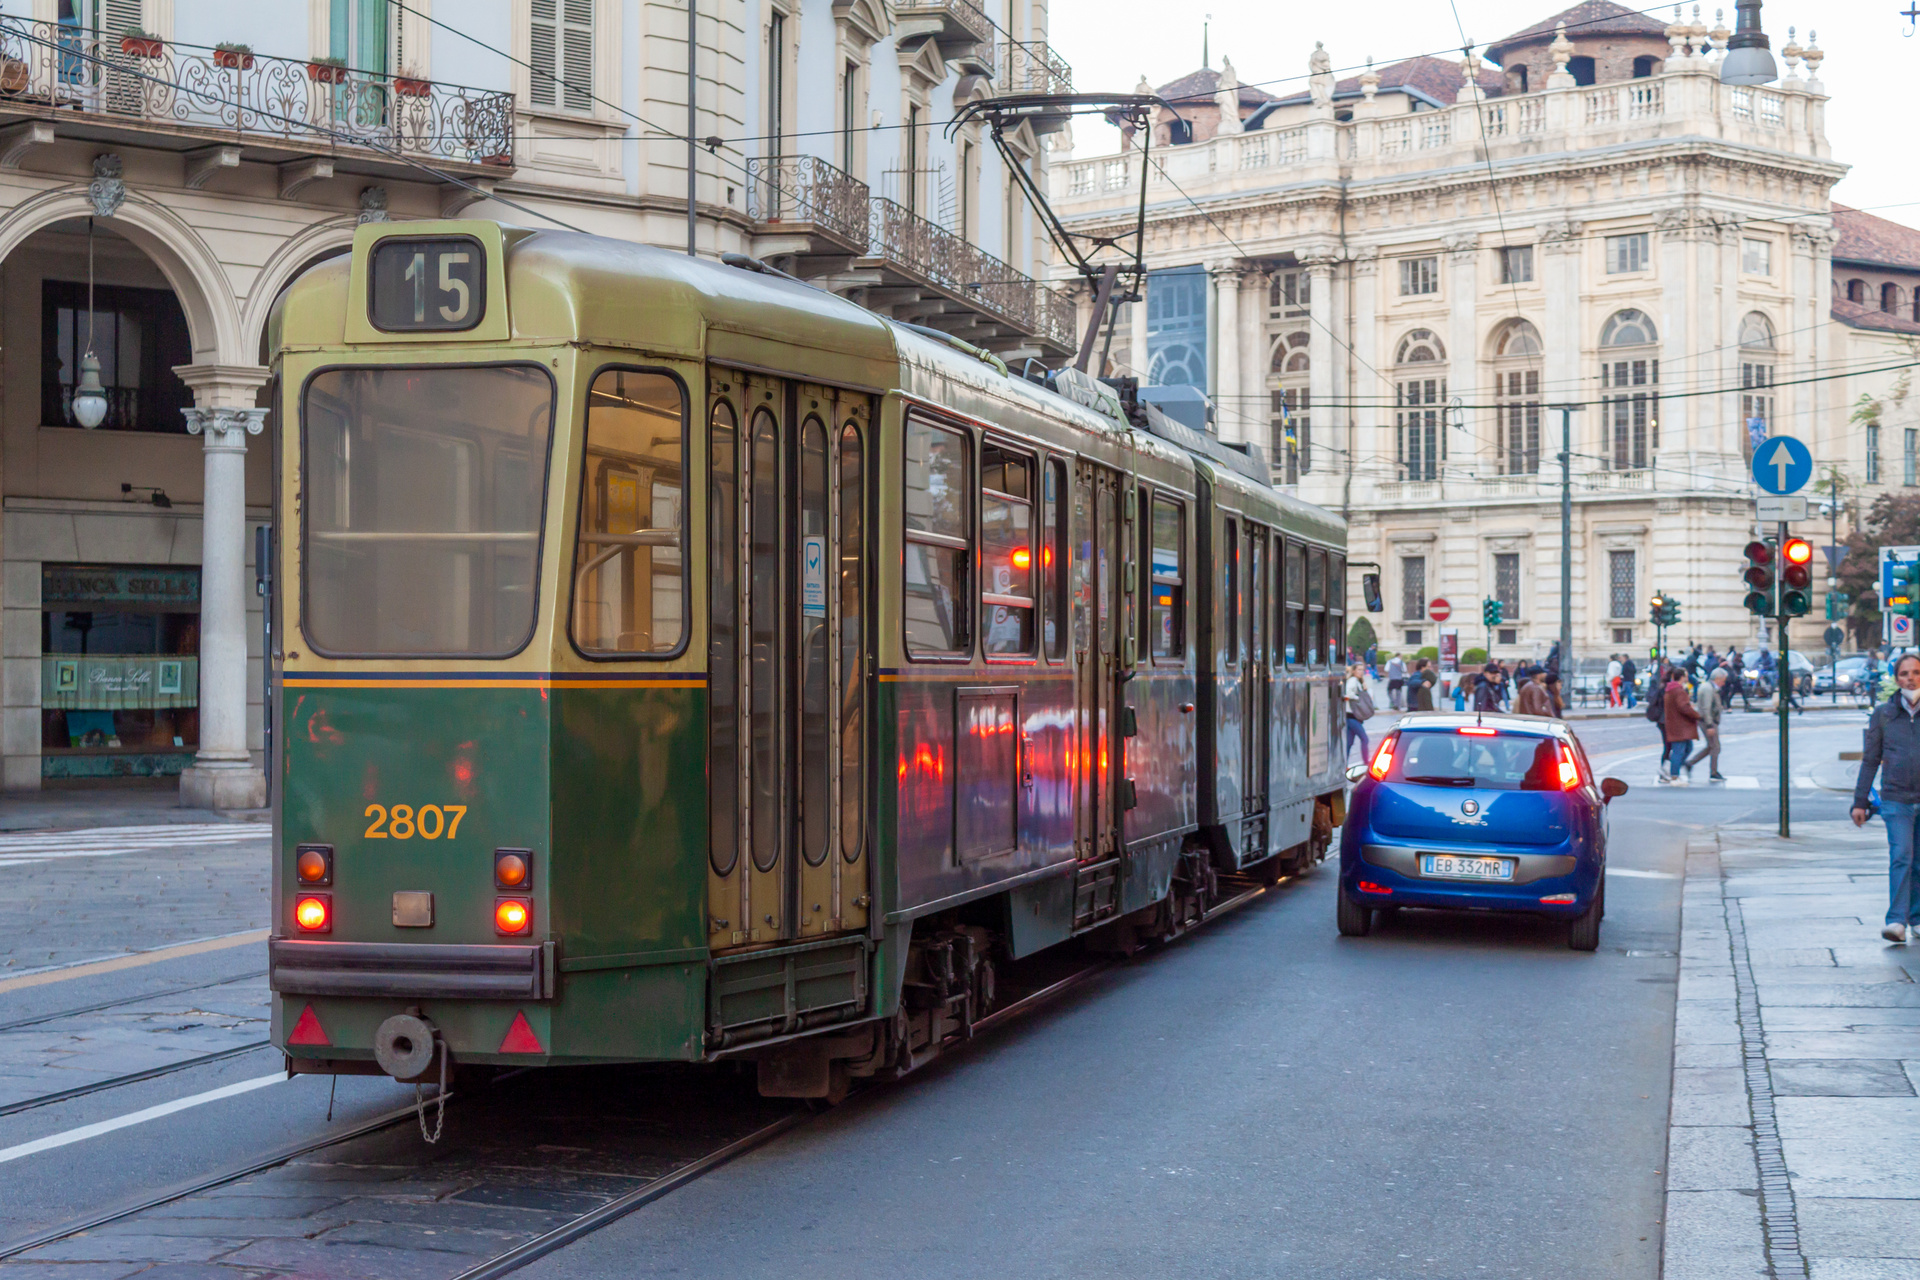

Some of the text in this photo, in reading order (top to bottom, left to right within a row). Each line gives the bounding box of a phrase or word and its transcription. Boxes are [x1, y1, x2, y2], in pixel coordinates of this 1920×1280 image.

[404, 252, 470, 322] 15
[128, 578, 190, 595] SELLA
[364, 803, 467, 840] 2807
[1435, 858, 1500, 875] EB 332MR
